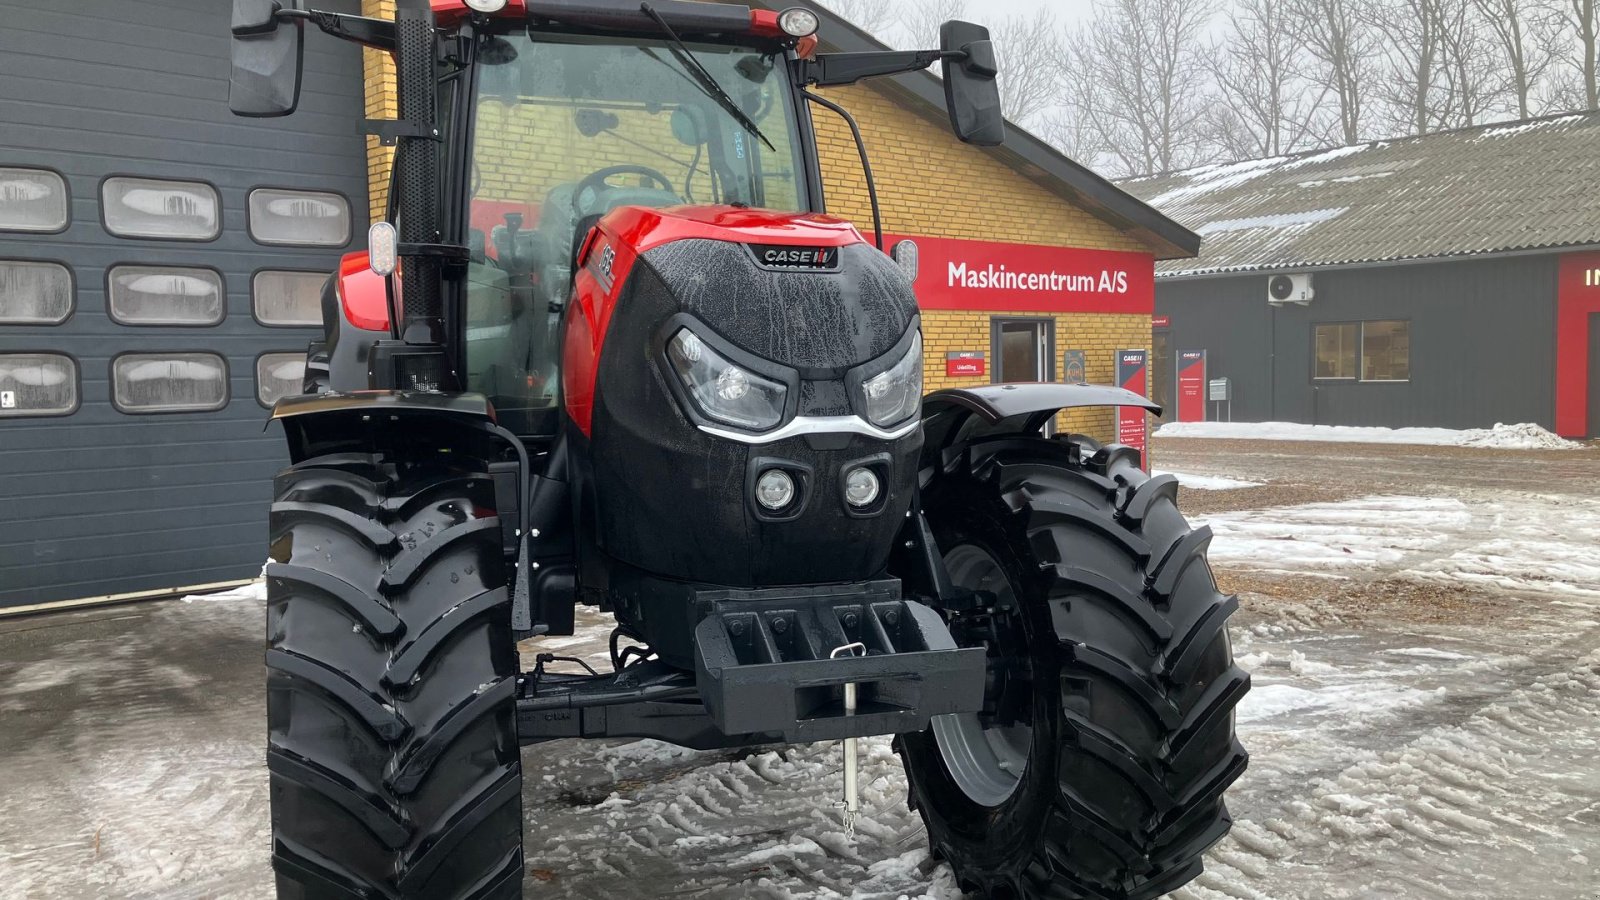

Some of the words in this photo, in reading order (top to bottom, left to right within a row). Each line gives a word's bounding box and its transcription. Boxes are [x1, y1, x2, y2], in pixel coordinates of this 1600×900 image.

[764, 249, 812, 263] CASE
[948, 261, 1094, 292] Maskincentrum
[1097, 270, 1128, 294] A/S
